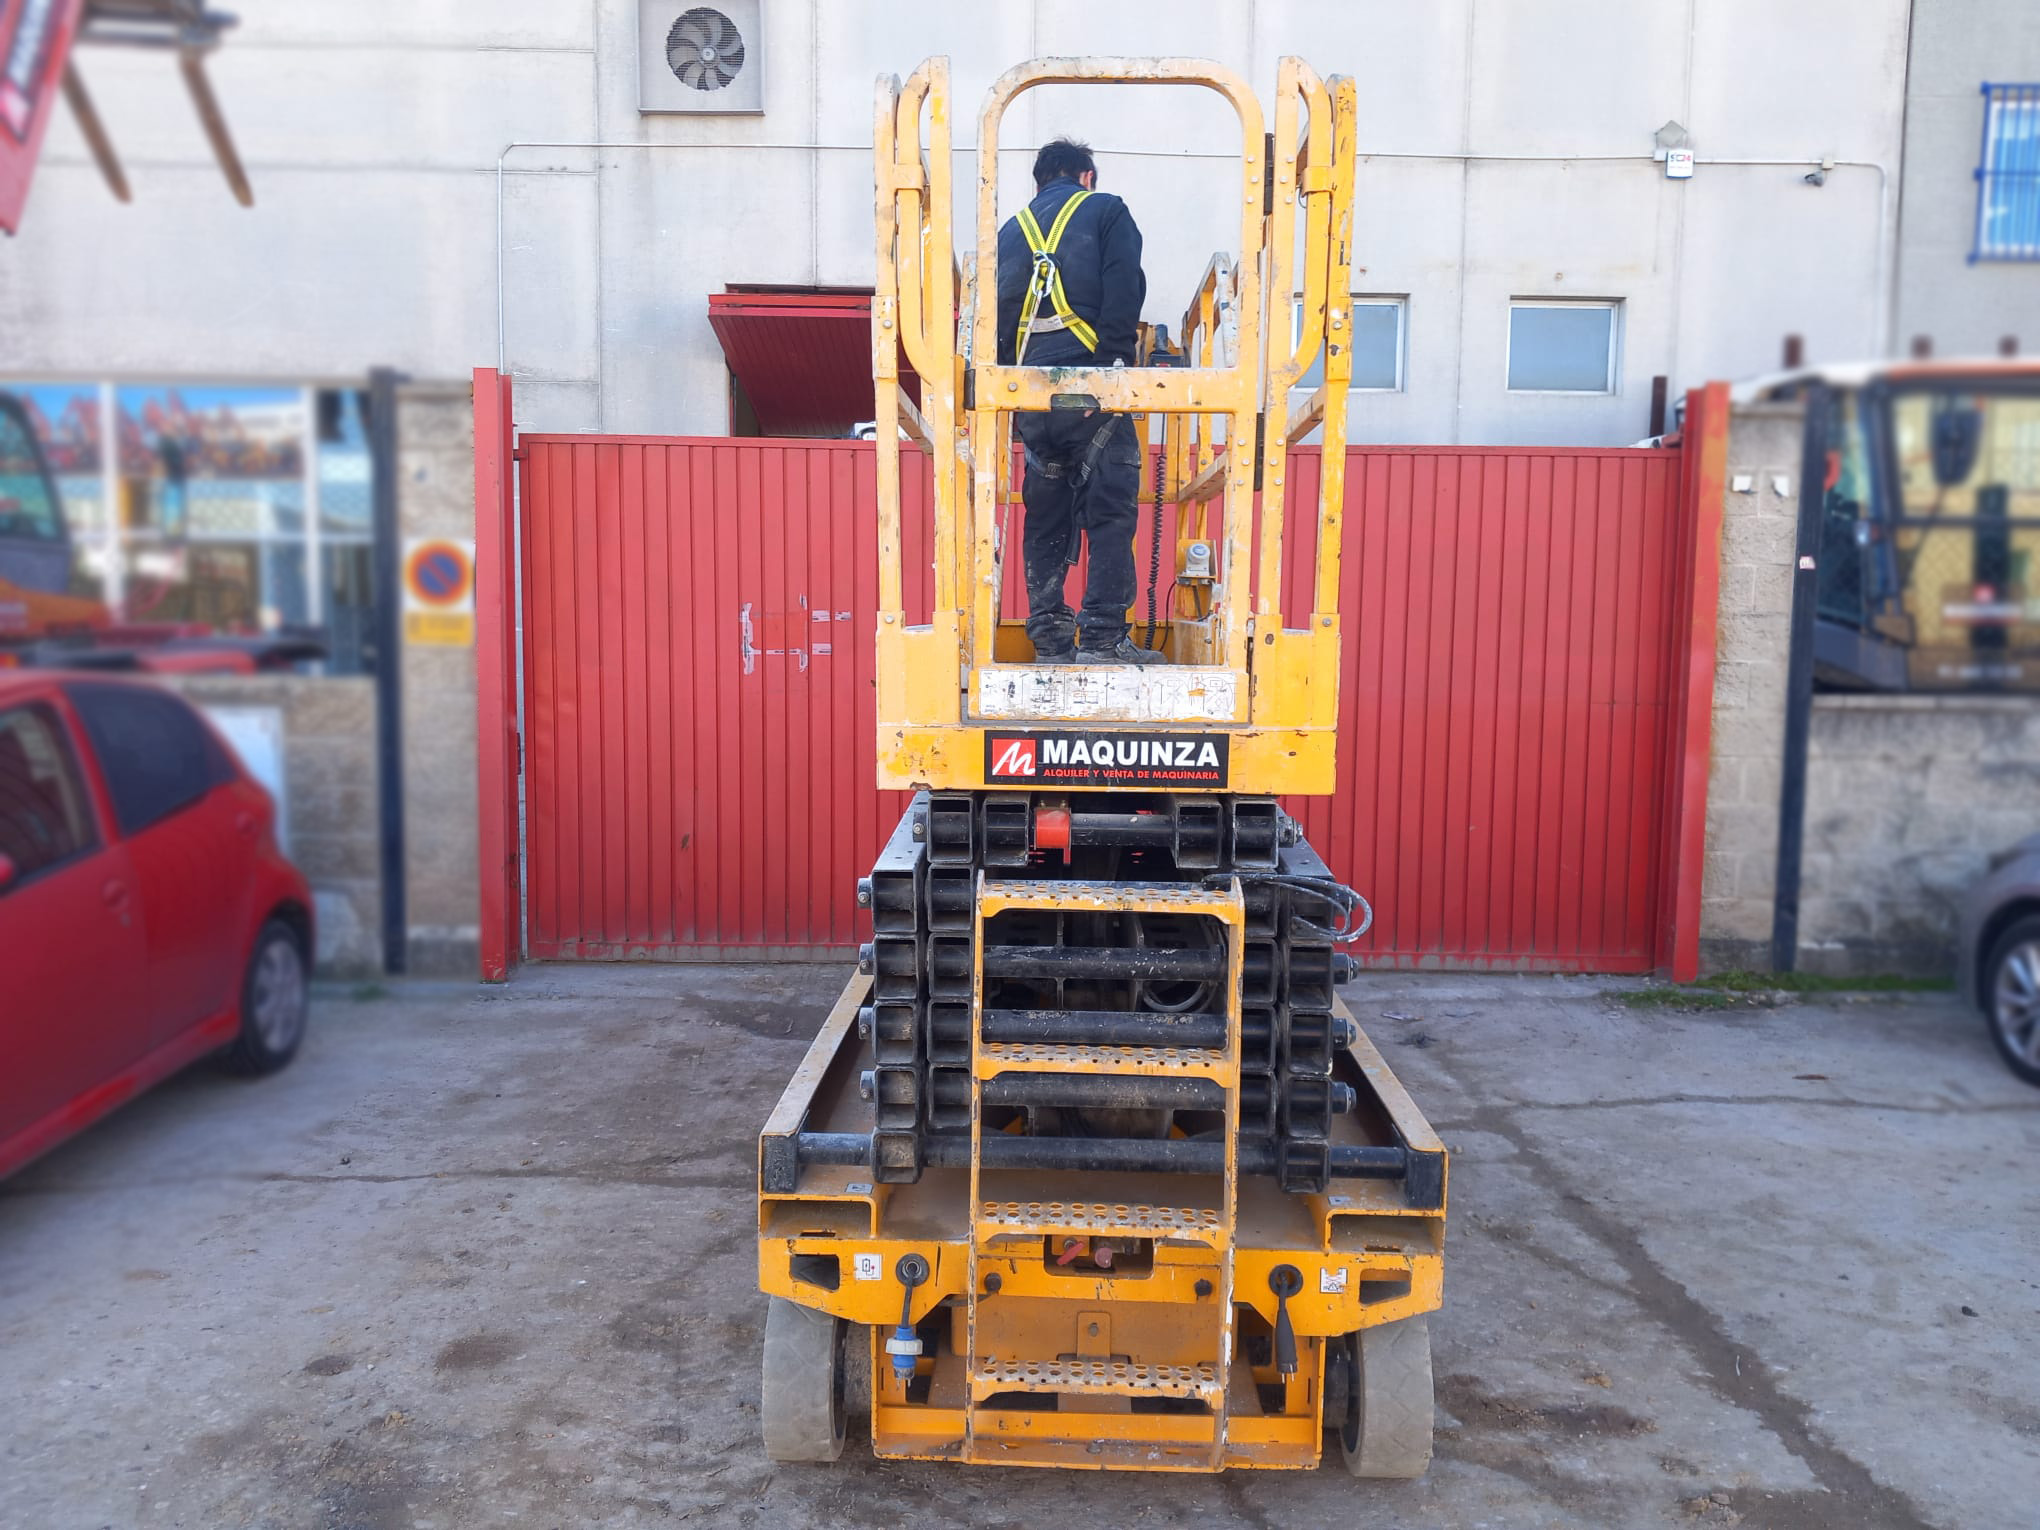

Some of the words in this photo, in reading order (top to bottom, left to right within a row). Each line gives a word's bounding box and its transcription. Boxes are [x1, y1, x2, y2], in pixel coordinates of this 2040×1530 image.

[1043, 739, 1219, 767] MAQUINZA
[1043, 768, 1090, 777] ALQUILER
[1093, 769, 1100, 778] Y
[1102, 770, 1135, 778] VENTA
[1137, 770, 1150, 778] DE
[1152, 770, 1219, 780] MAQUINARIA
